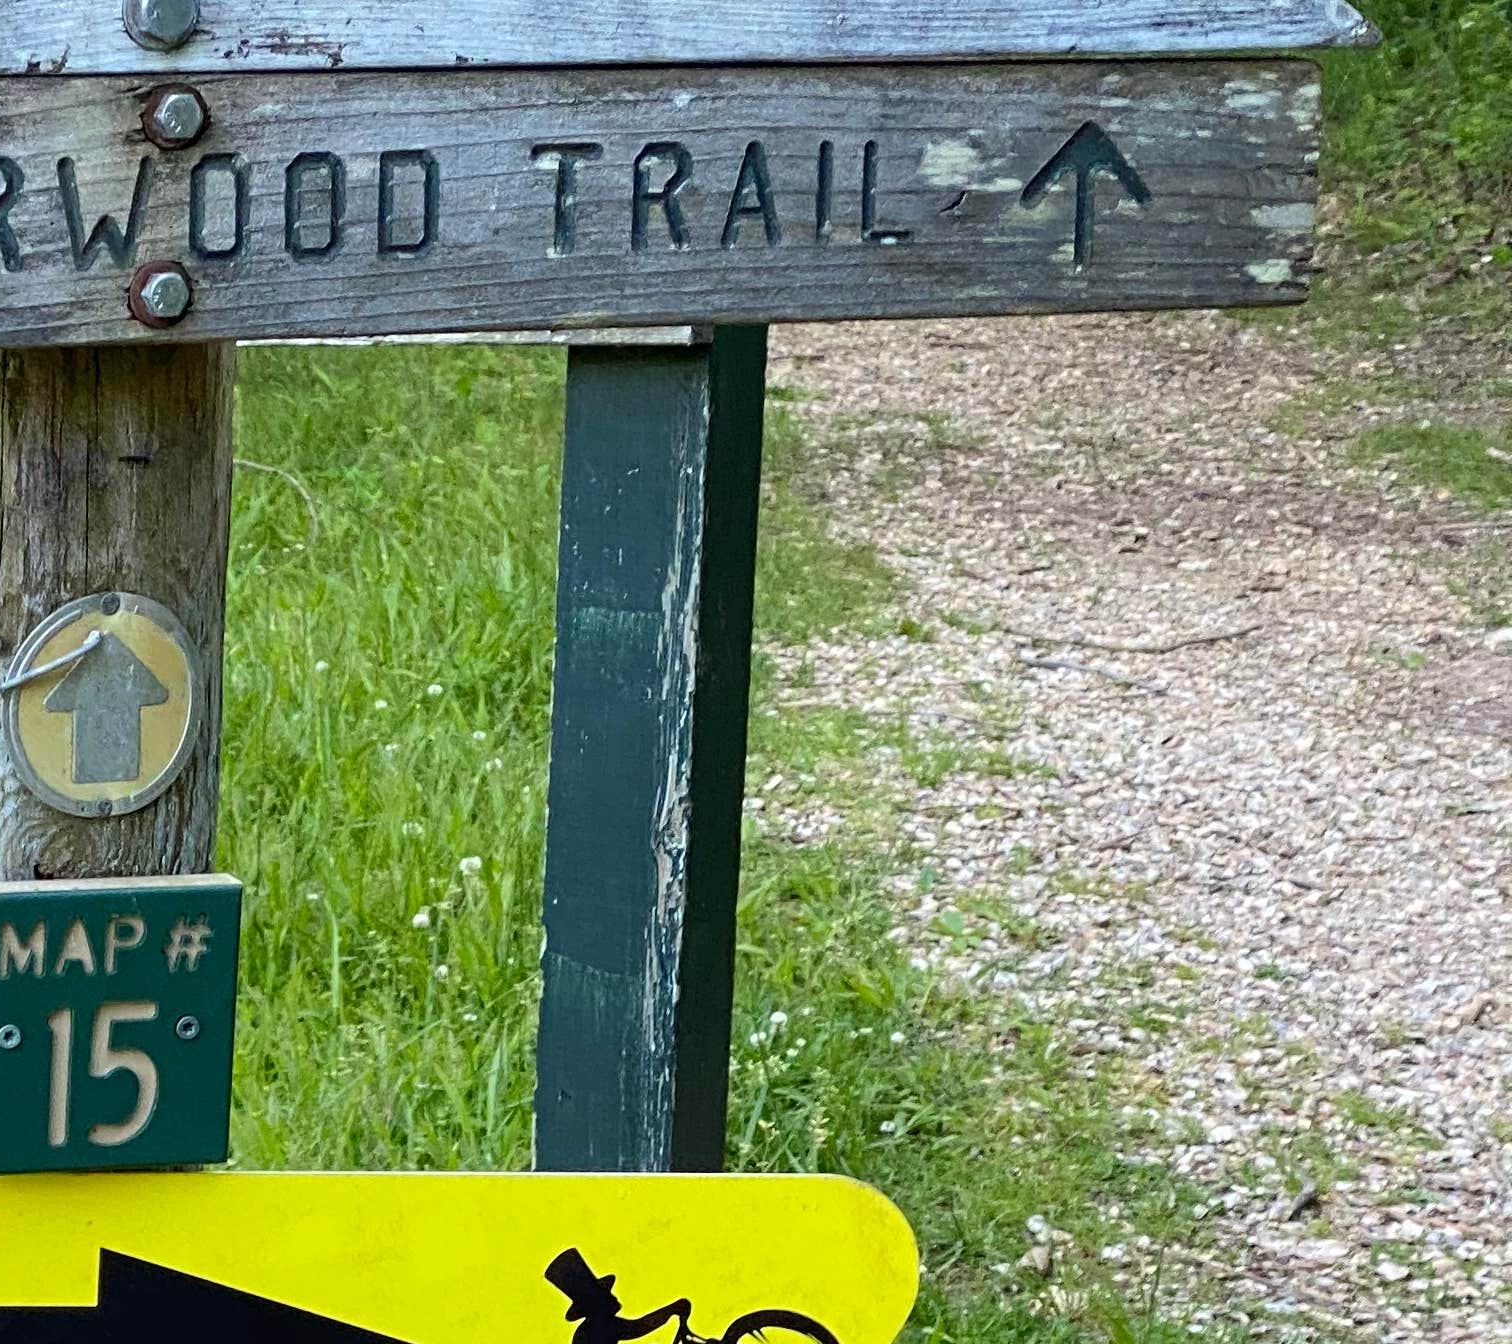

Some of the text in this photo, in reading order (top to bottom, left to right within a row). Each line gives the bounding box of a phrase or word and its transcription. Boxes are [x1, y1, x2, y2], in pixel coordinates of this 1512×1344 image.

[530, 139, 916, 256] TRAIL
[164, 912, 214, 974] #
[47, 1000, 159, 1147] 15
